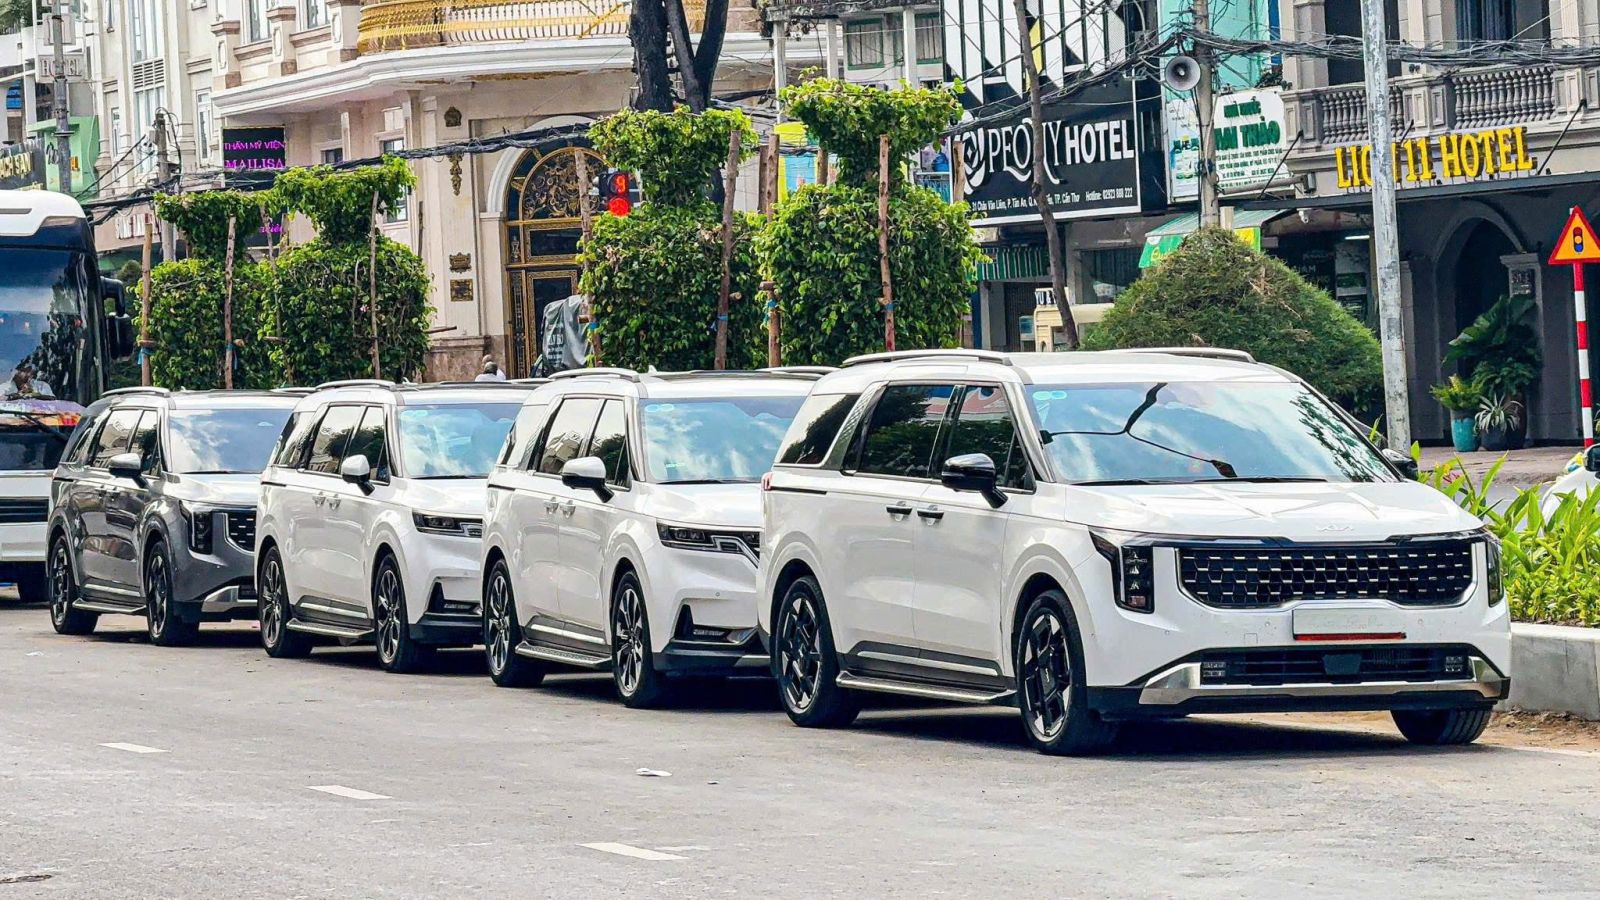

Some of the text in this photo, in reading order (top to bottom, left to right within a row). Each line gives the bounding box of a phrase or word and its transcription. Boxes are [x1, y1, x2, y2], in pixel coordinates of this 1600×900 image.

[225, 158, 284, 169] MAILISA
[987, 117, 1135, 184] PEOY HOTEL
[1439, 126, 1533, 177] HOTEL
